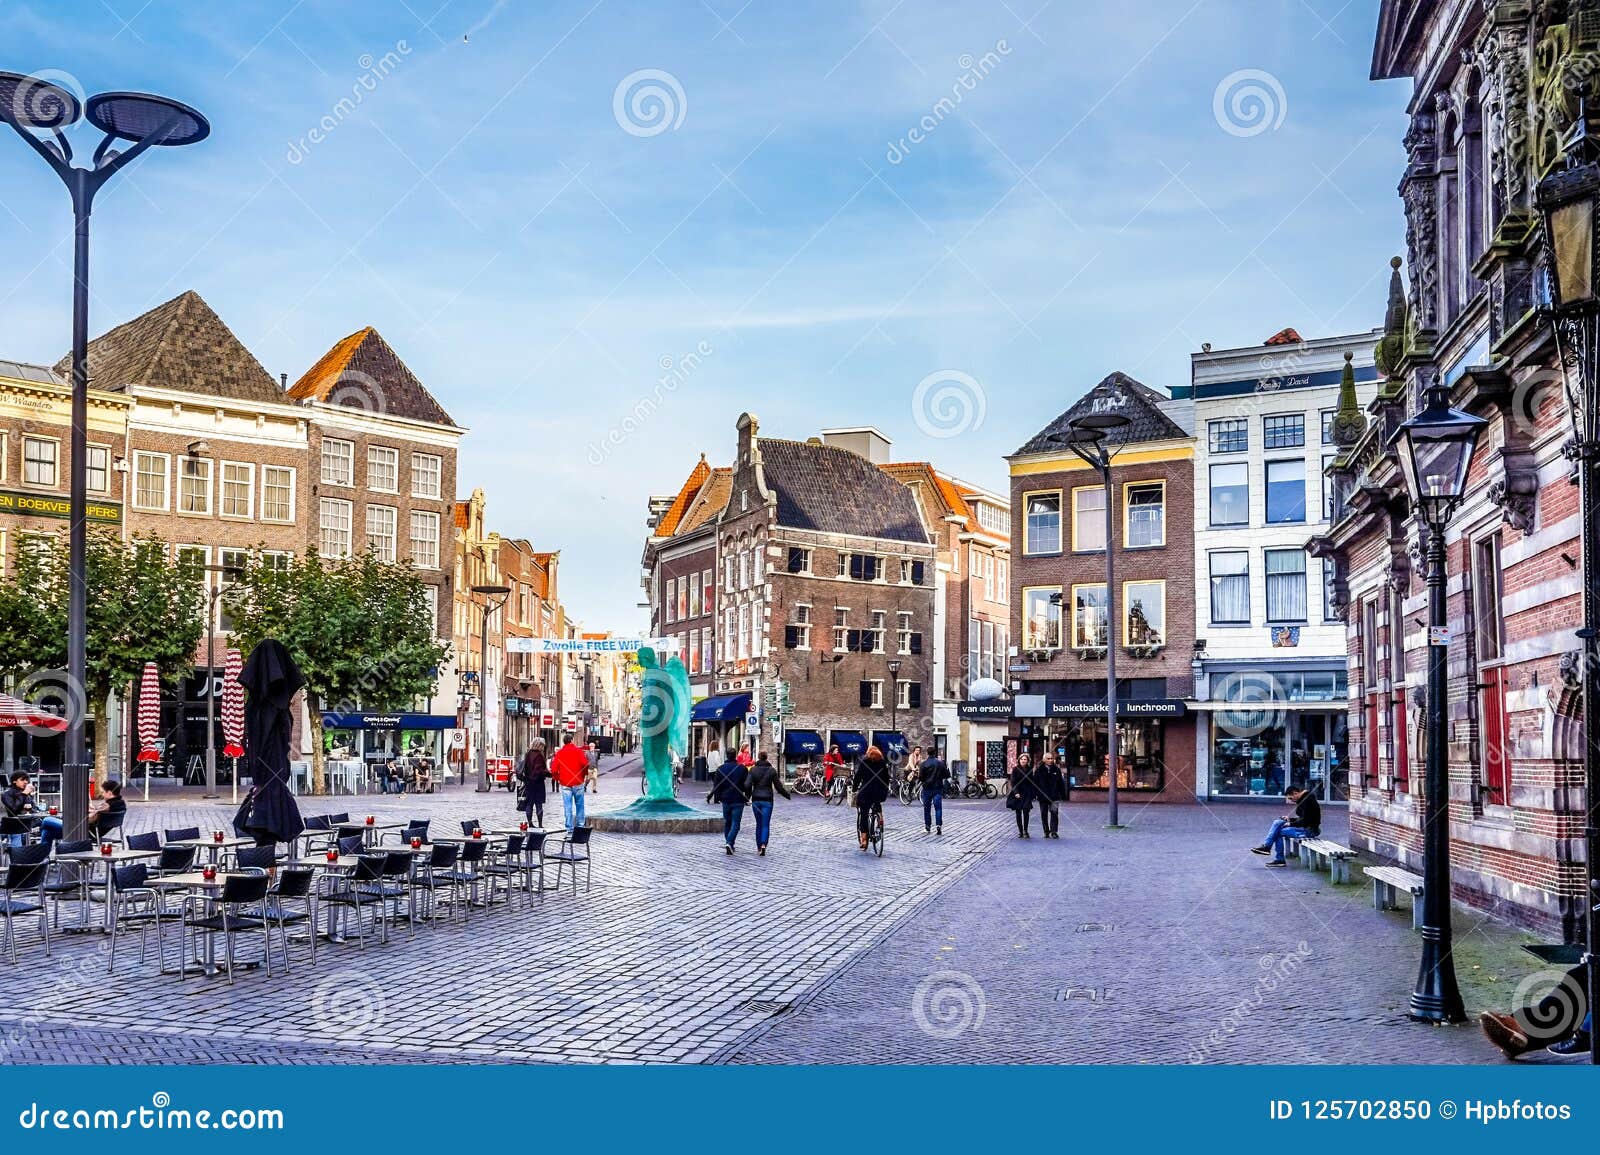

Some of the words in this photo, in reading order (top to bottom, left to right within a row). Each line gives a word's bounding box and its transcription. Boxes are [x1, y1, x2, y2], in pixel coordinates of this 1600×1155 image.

[1287, 377, 1309, 387] David
[14, 396, 53, 409] Waanders
[543, 640, 583, 651] Zwolle
[587, 641, 616, 650] FREE
[619, 640, 643, 650] WiFi
[1053, 703, 1120, 714] banketbakkej
[1126, 703, 1175, 712] lunchroom
